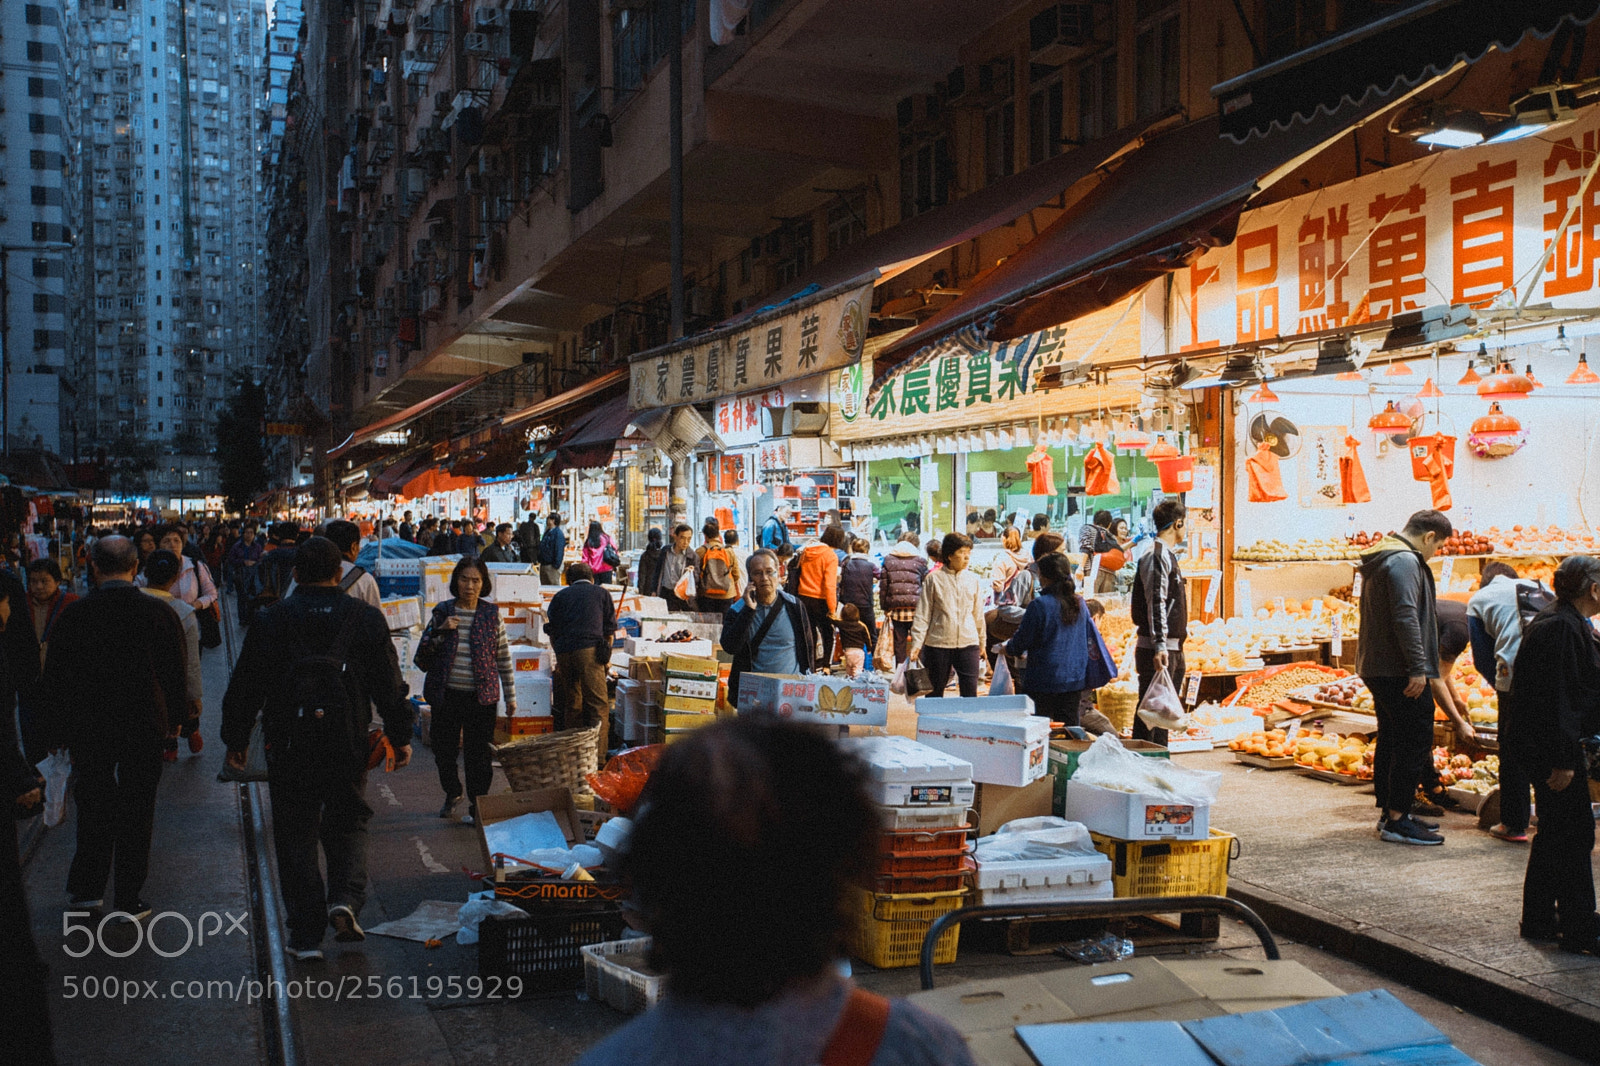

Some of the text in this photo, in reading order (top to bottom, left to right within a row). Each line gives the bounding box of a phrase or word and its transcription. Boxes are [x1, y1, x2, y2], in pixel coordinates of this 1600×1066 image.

[656, 312, 820, 401] 家農優質果菜
